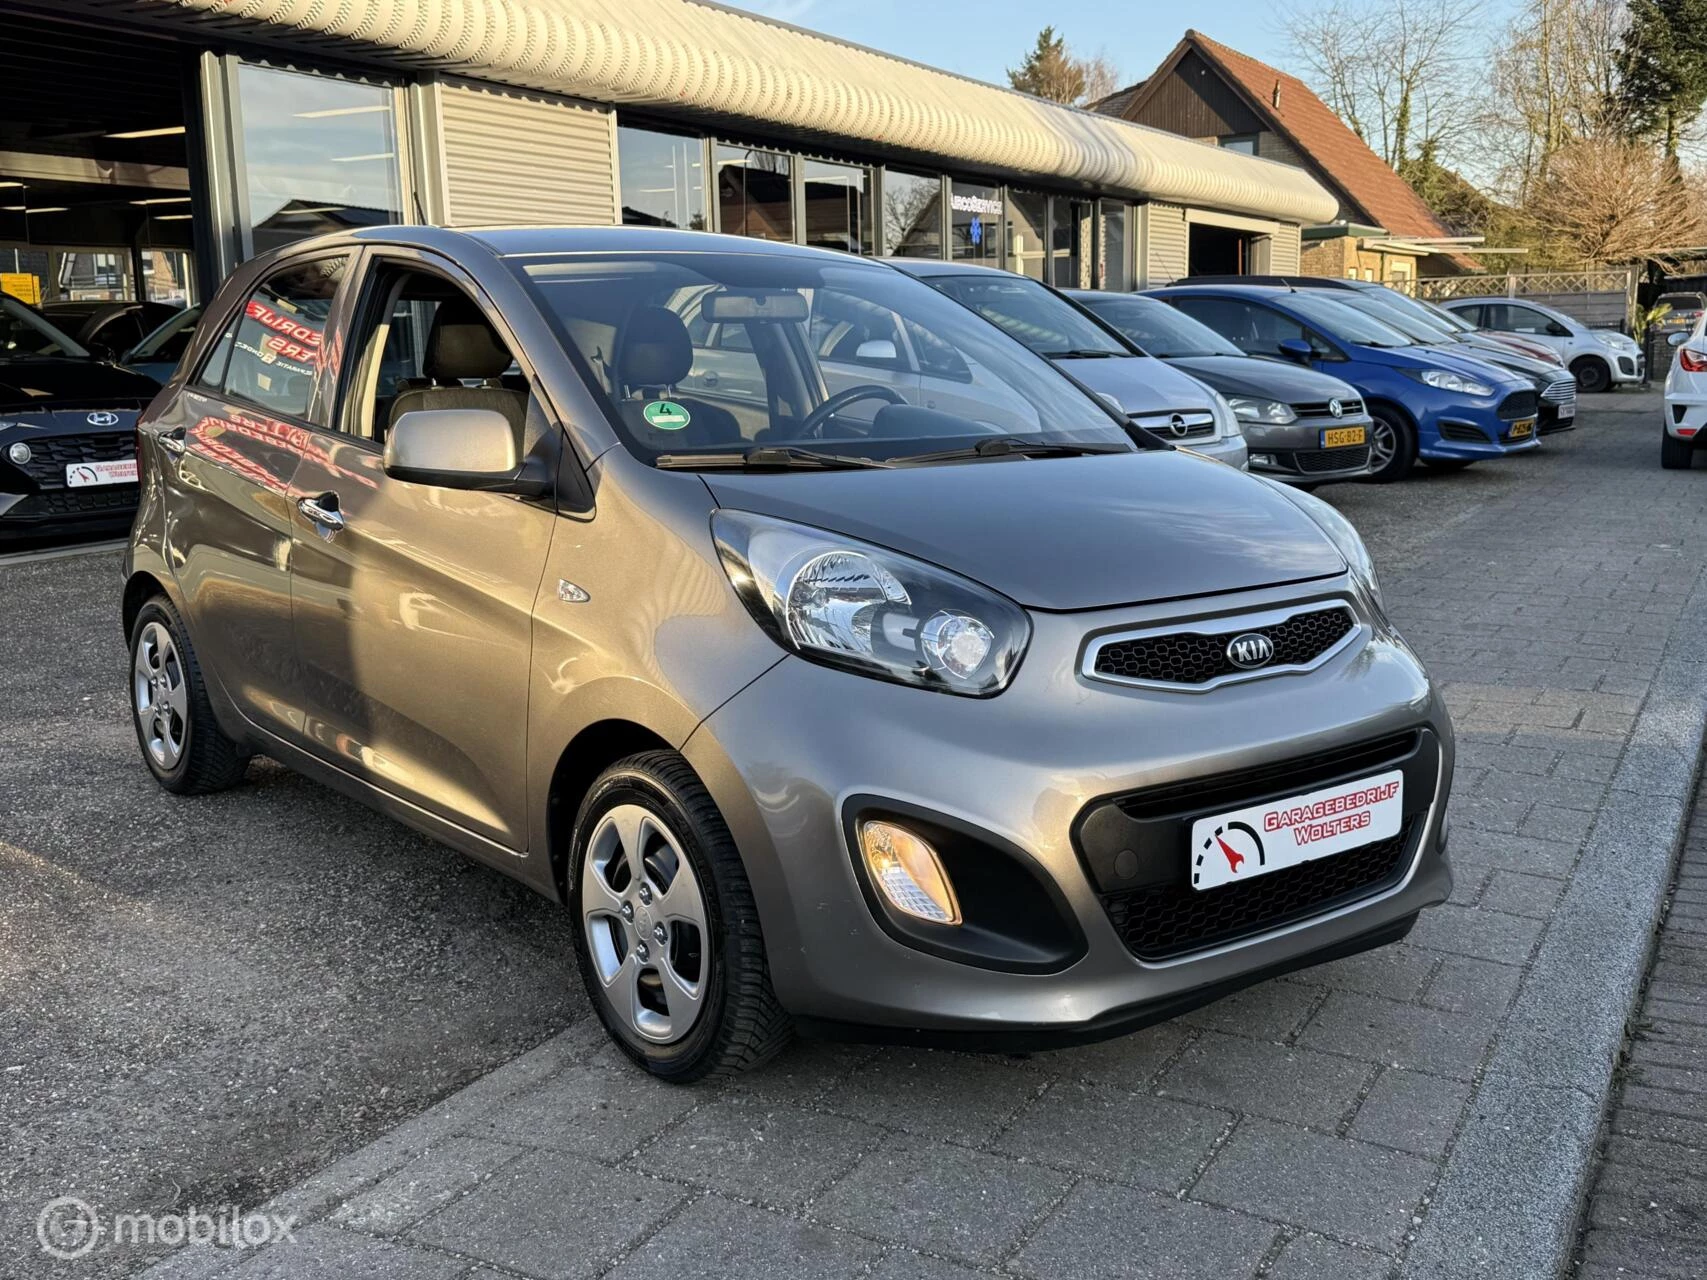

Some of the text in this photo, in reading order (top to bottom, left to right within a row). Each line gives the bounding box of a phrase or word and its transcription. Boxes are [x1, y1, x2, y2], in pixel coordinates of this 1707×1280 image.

[659, 403, 672, 415] 4
[1235, 641, 1270, 663] KIA
[1264, 781, 1399, 832] GARAGEBEDRIJF
[1294, 811, 1370, 846] WOLTERS
